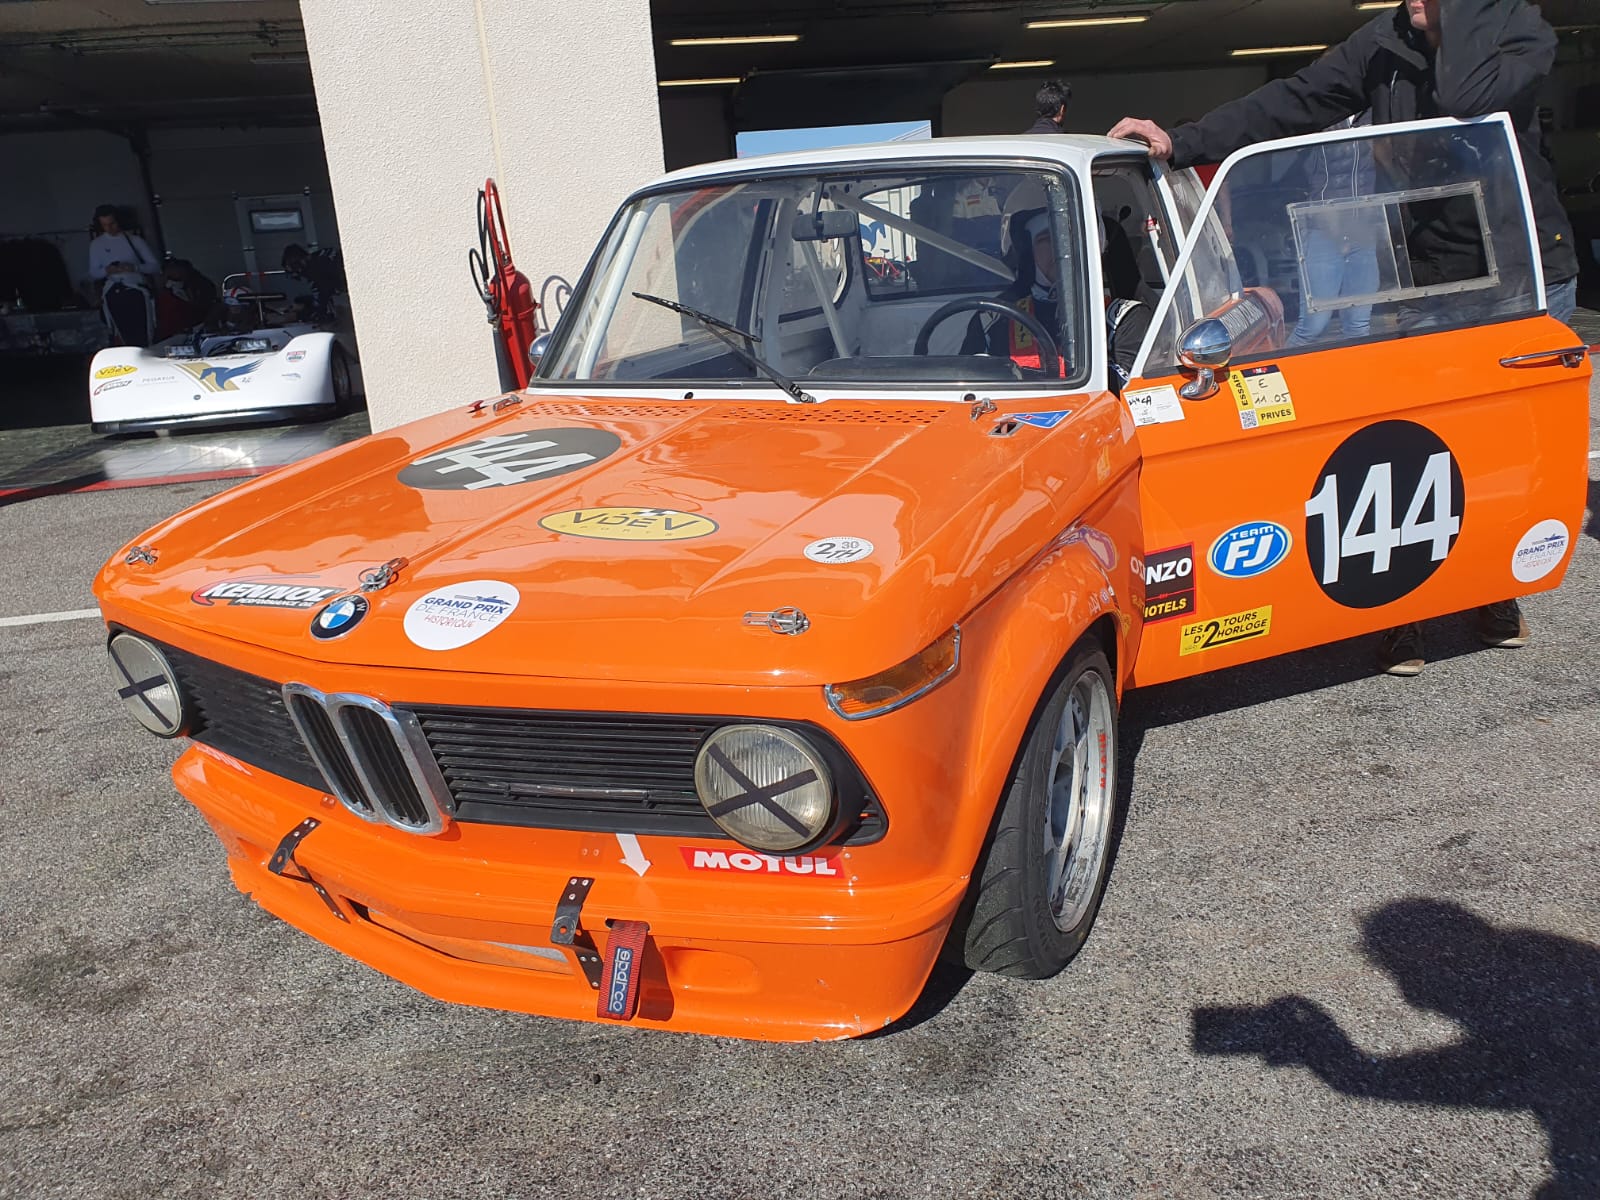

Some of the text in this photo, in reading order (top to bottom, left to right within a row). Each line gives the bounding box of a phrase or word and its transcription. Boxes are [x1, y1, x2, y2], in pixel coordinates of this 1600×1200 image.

[1231, 374, 1249, 406] ESSAIS
[1260, 408, 1292, 421] PRIVES
[409, 433, 597, 491] 144
[1305, 451, 1460, 585] 144
[1230, 525, 1274, 541] TEAM
[1223, 534, 1274, 571] FJ
[1517, 540, 1565, 557] GRAND PRIX
[200, 582, 336, 603] KENNOL
[415, 603, 500, 622] DE FRANCE
[424, 597, 505, 614] GRAND PRIX
[424, 614, 475, 628] HISTORIQUE
[1184, 625, 1203, 636] LES
[1223, 612, 1258, 626] TOURS
[1217, 619, 1268, 638] HORLOGE
[694, 850, 837, 875] MOTUL
